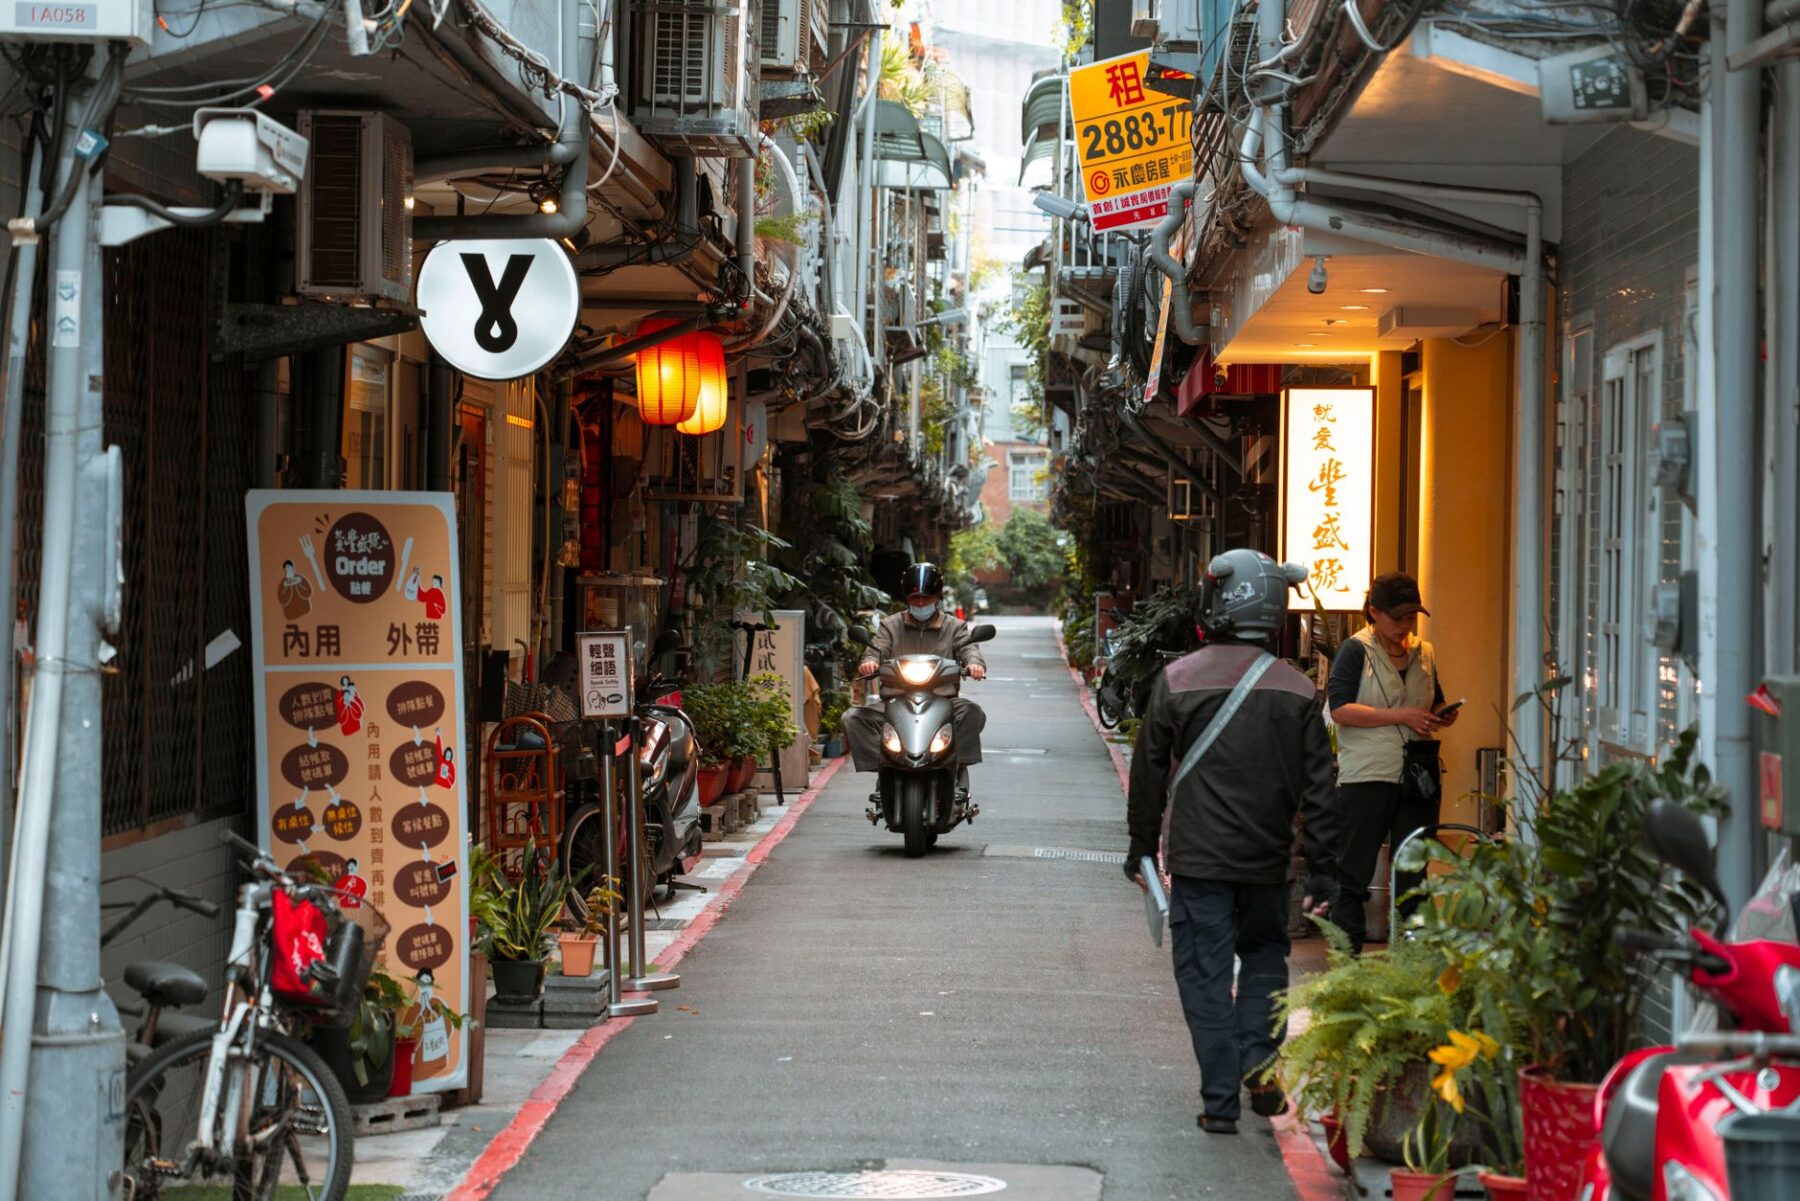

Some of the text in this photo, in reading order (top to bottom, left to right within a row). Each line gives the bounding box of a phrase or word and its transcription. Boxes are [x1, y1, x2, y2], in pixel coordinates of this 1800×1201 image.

[1105, 61, 1146, 107] 租
[1112, 158, 1171, 190] 永慶房屋
[335, 556, 386, 576] Order
[386, 621, 441, 657] 外帶
[589, 643, 616, 659] 輕聲
[590, 660, 617, 676] 細語
